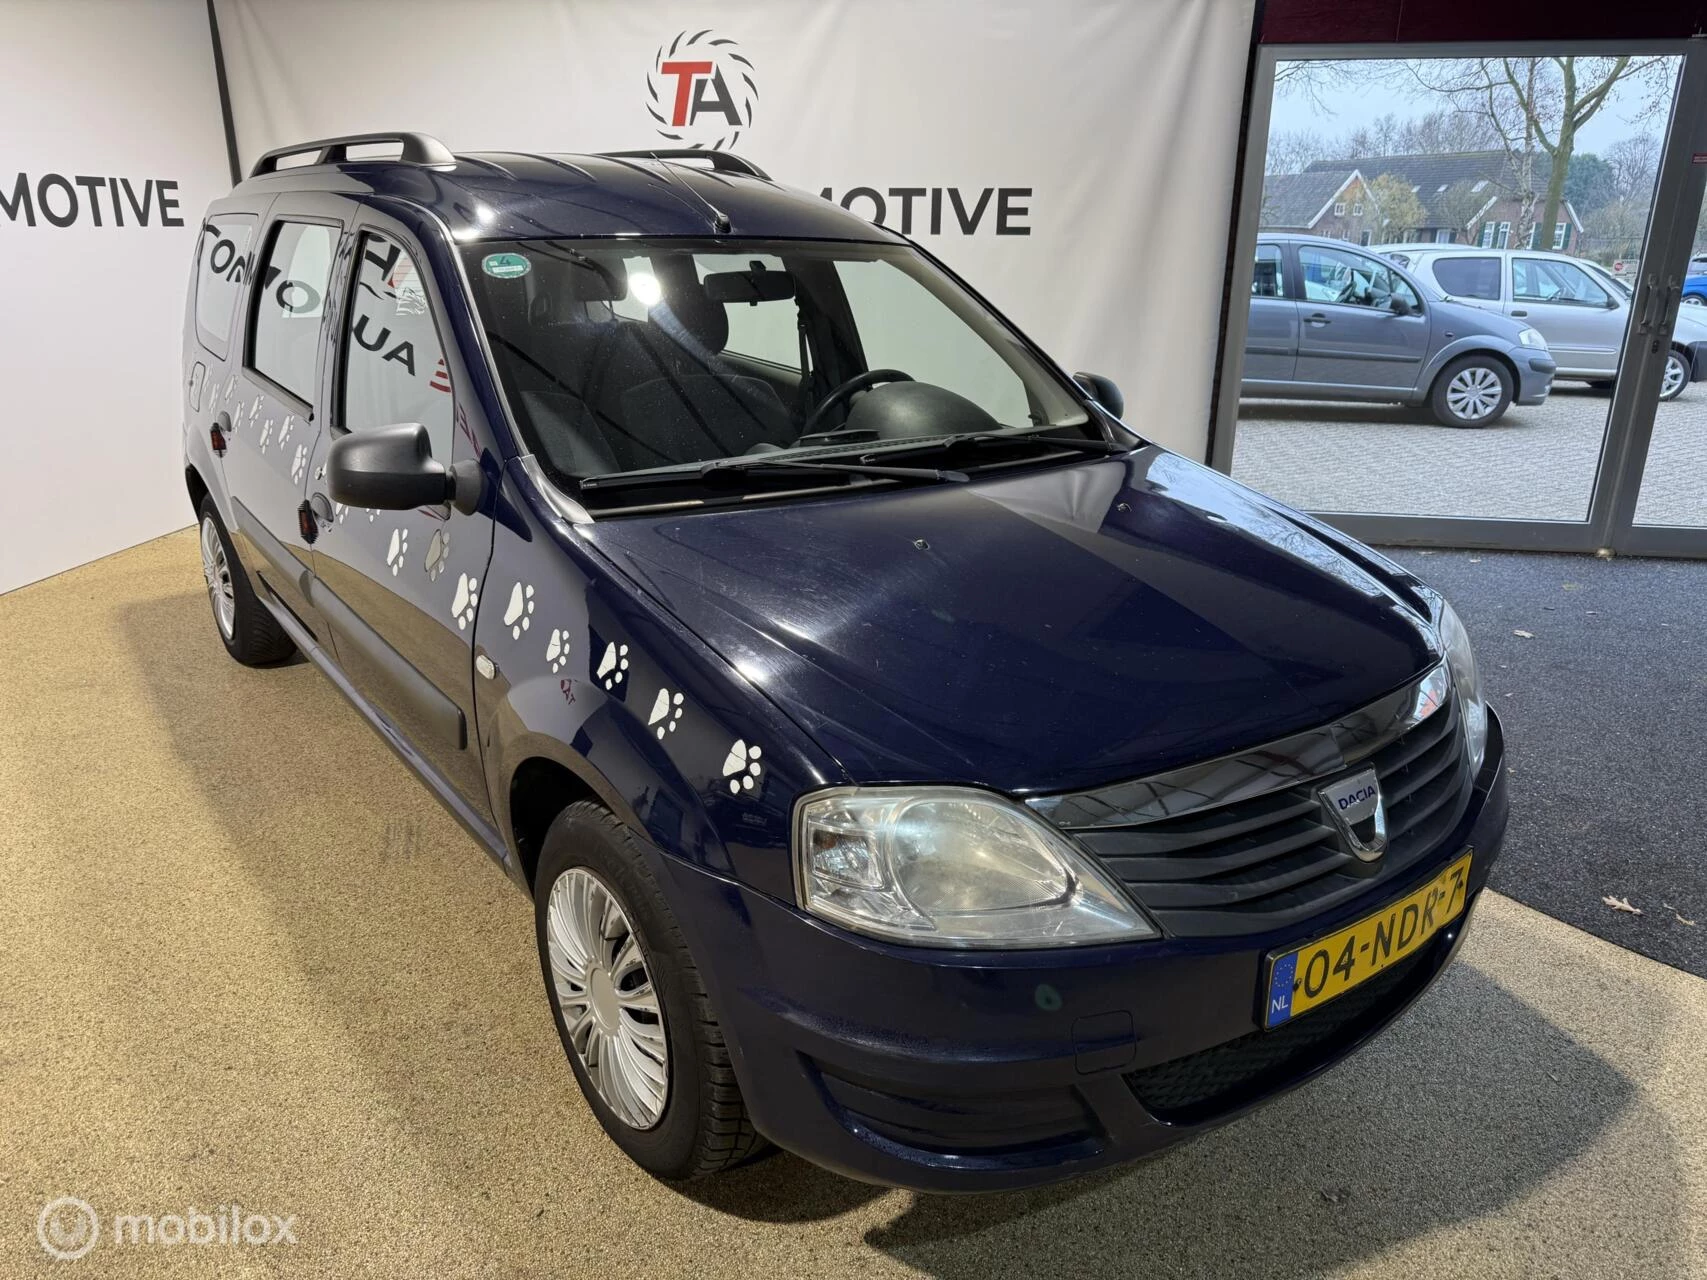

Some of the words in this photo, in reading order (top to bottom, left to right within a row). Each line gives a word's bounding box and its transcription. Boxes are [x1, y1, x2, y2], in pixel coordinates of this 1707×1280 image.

[660, 60, 743, 127] TA
[820, 186, 1033, 236] OTIVE
[1338, 785, 1376, 810] DACIA
[1303, 867, 1465, 999] 04-NDR-7
[1271, 995, 1289, 1014] NL
